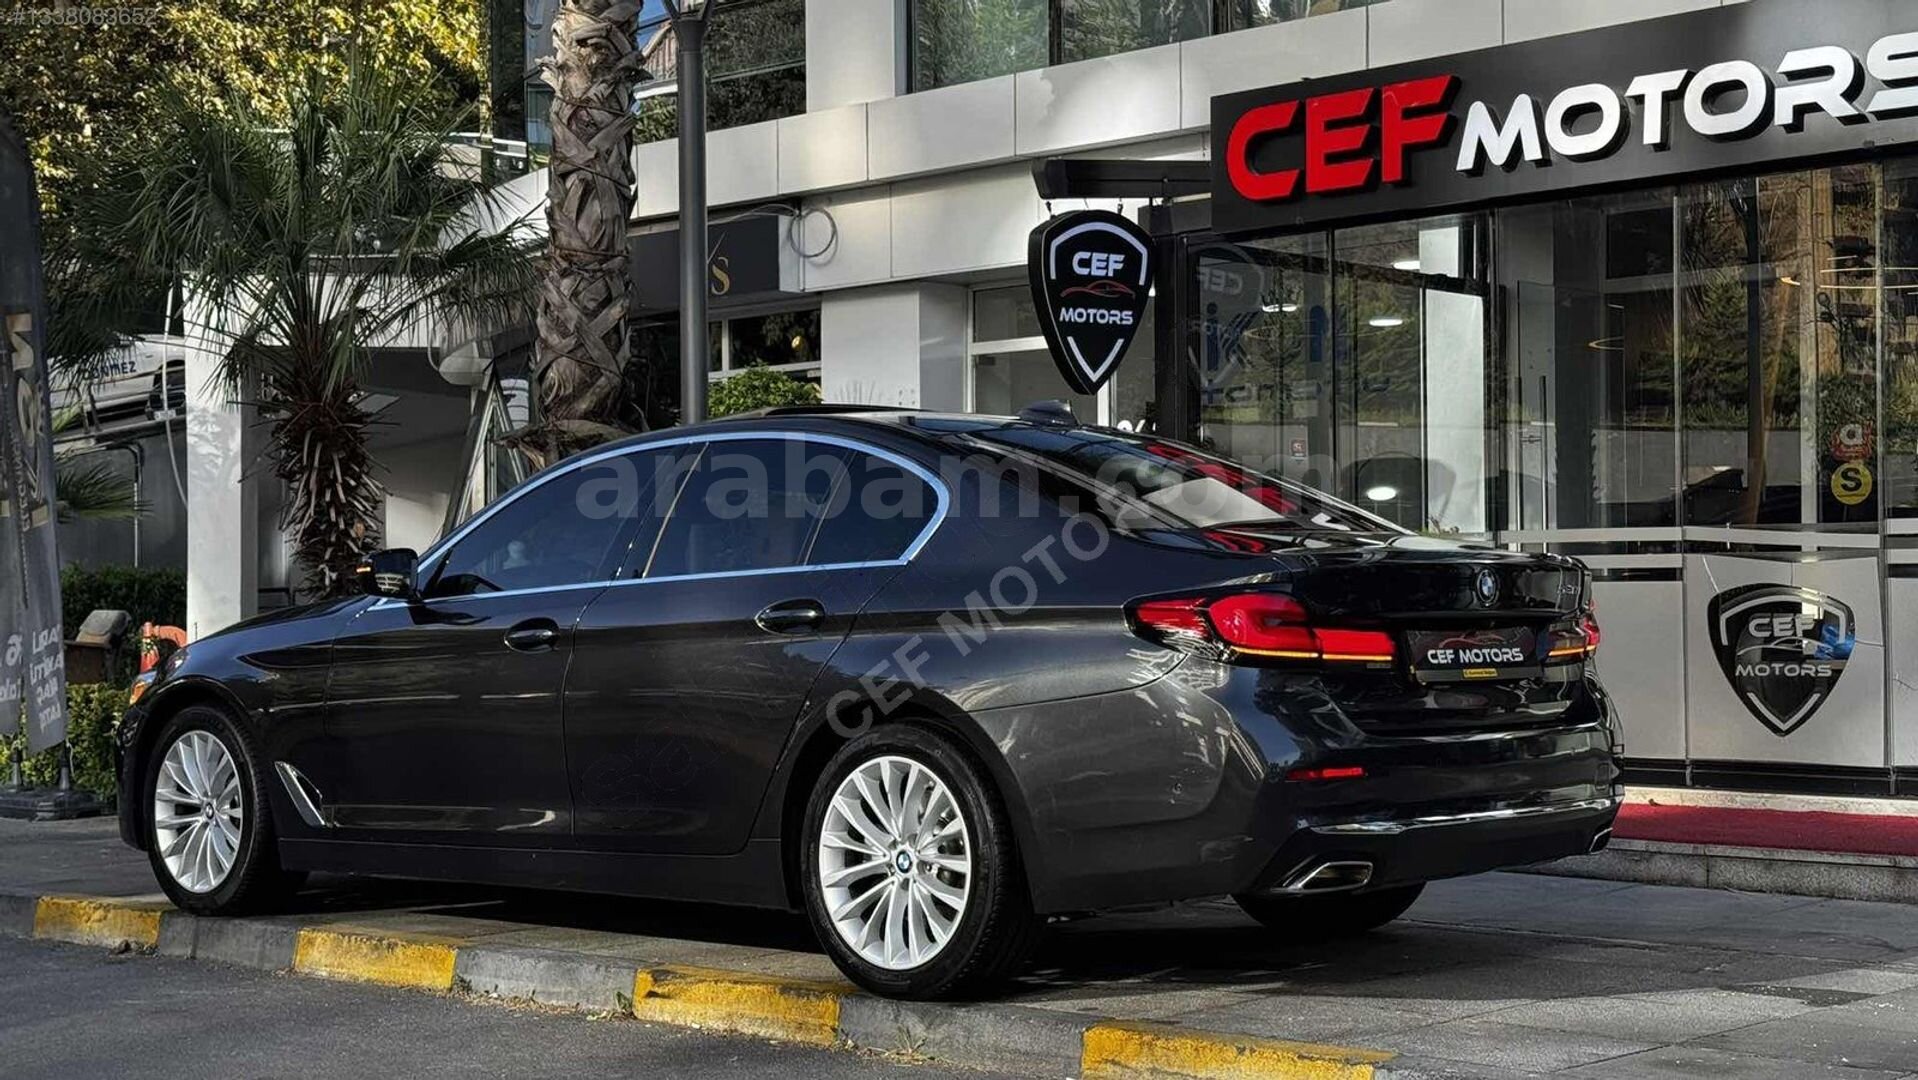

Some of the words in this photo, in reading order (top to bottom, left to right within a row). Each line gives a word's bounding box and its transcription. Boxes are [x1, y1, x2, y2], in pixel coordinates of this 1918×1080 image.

[1226, 75, 1454, 200] CEF
[1456, 33, 1918, 172] MOTORS
[1072, 251, 1125, 277] CEF
[1059, 307, 1133, 325] MOTORS
[1841, 467, 1863, 492] S
[1749, 614, 1816, 637] CEF
[1427, 649, 1455, 664] CEF
[1459, 647, 1524, 664] MOTORS
[1735, 663, 1832, 677] MOTORS
